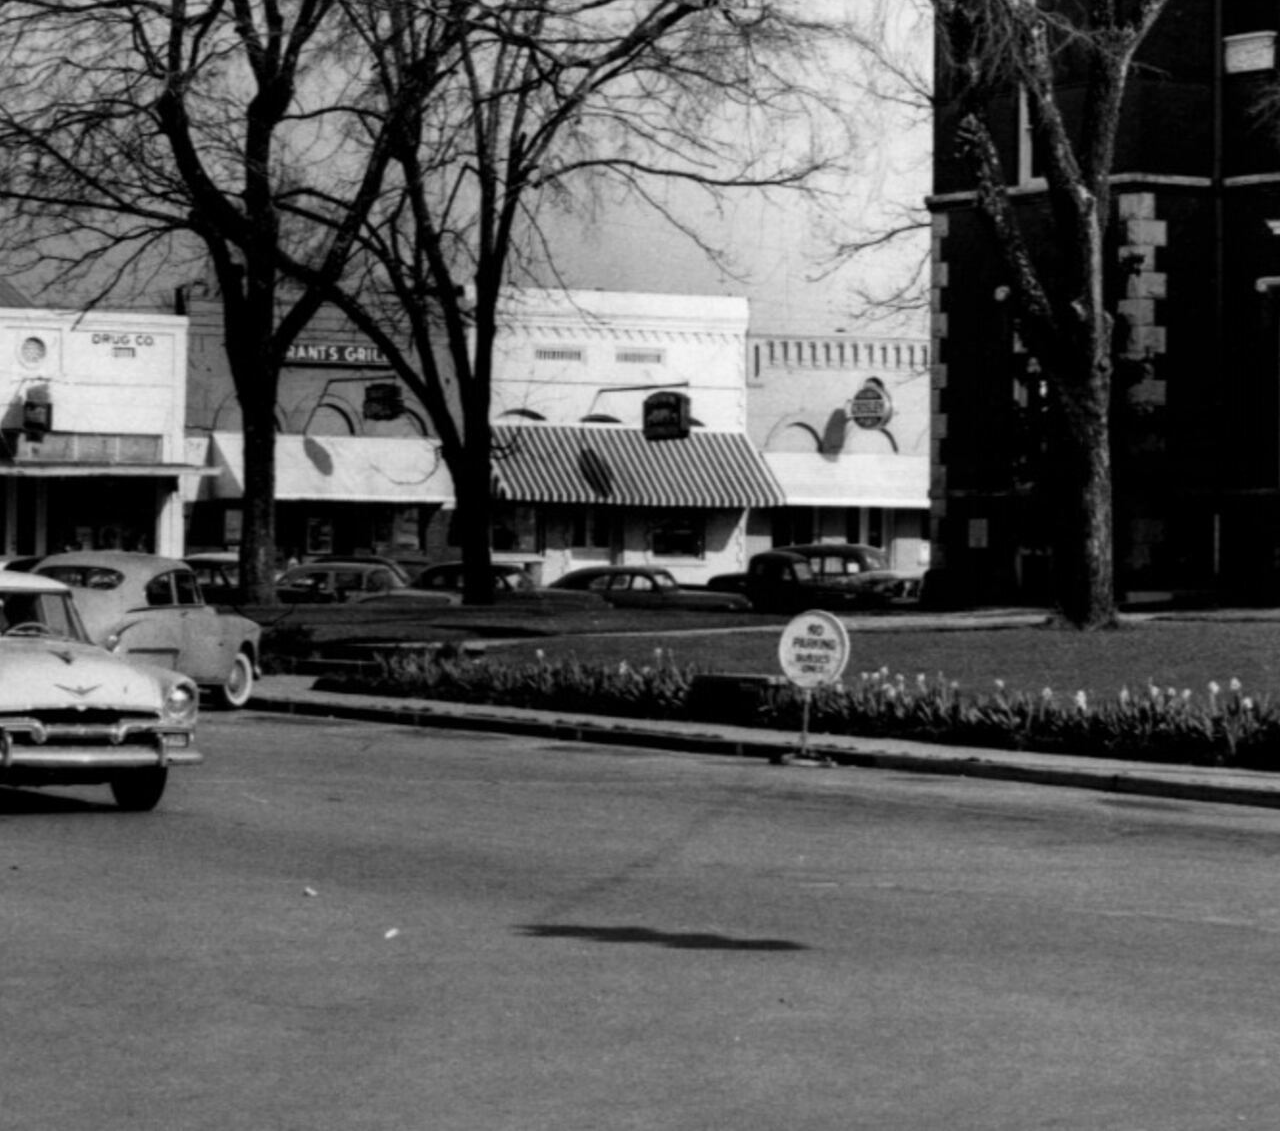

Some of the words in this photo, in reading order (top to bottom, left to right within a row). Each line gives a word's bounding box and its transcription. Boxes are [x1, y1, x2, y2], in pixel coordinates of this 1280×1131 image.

[92, 333, 130, 346] DRUG
[285, 345, 338, 361] RANTS
[344, 346, 389, 362] GRIL
[807, 623, 824, 636] NO
[793, 637, 836, 651] PARKING
